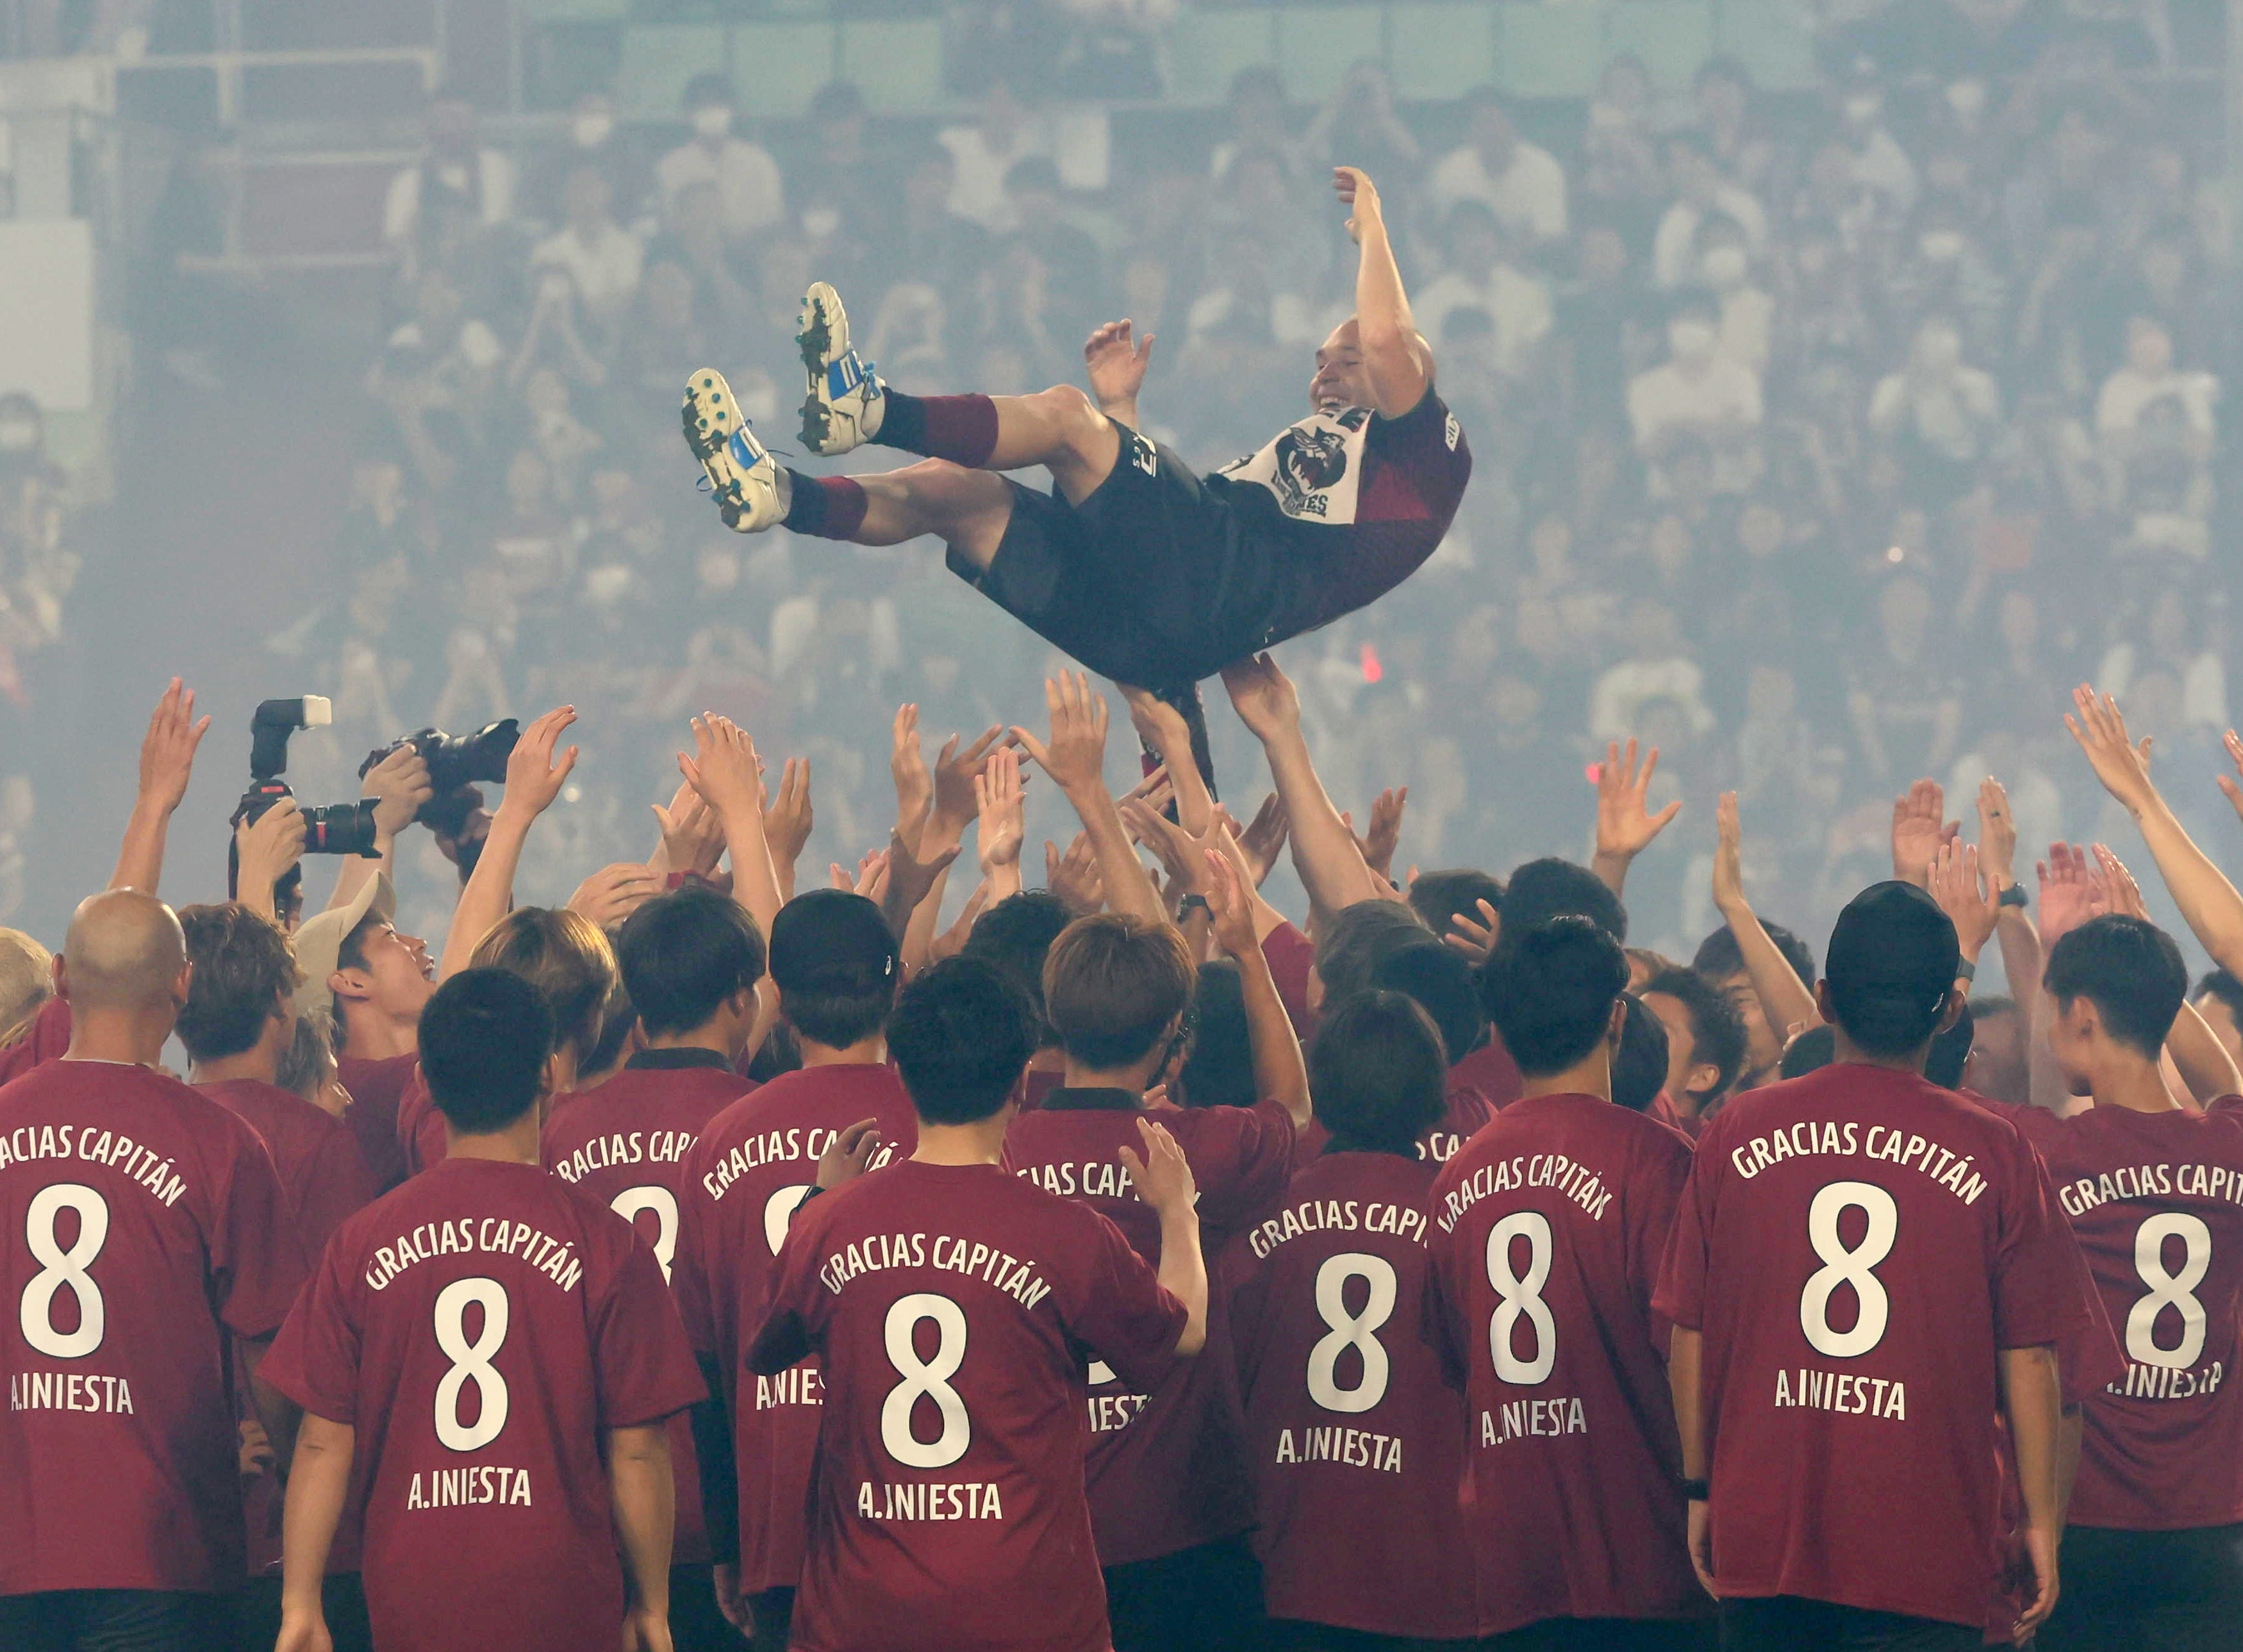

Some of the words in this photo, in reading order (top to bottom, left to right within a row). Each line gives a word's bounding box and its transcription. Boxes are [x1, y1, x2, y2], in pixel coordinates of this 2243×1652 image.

[0, 1125, 73, 1169] ACIAS
[78, 1127, 187, 1207] CAPITÁN
[549, 1132, 642, 1184] RACIAS
[703, 1128, 800, 1201] GRACIAS
[1732, 1121, 1858, 1179] GRACIAS
[1866, 1126, 1988, 1205] CAPITÁN
[2060, 1164, 2171, 1216] GRACIAS
[2176, 1164, 2243, 1204] CAPIT
[479, 1218, 583, 1292] CAPITÁN
[1250, 1200, 1358, 1259] GRACIAS
[1364, 1203, 1427, 1249] CAPI
[21, 1184, 108, 1358] 8
[820, 1233, 926, 1294] GRACIAS
[932, 1235, 1052, 1310] CAPITÁN
[1486, 1212, 1556, 1384] 8
[1800, 1182, 1898, 1357] 8
[2126, 1212, 2211, 1369] 8
[435, 1278, 508, 1451] 8
[1307, 1253, 1396, 1412] 8
[12, 1372, 133, 1414] A.INIESTA
[881, 1293, 970, 1468] 8
[1775, 1369, 1905, 1421] A.INIESTA
[1276, 1427, 1401, 1473] A.INIESTA
[408, 1466, 531, 1510] A.INIESTA
[858, 1482, 1002, 1521] A.INIESTA
